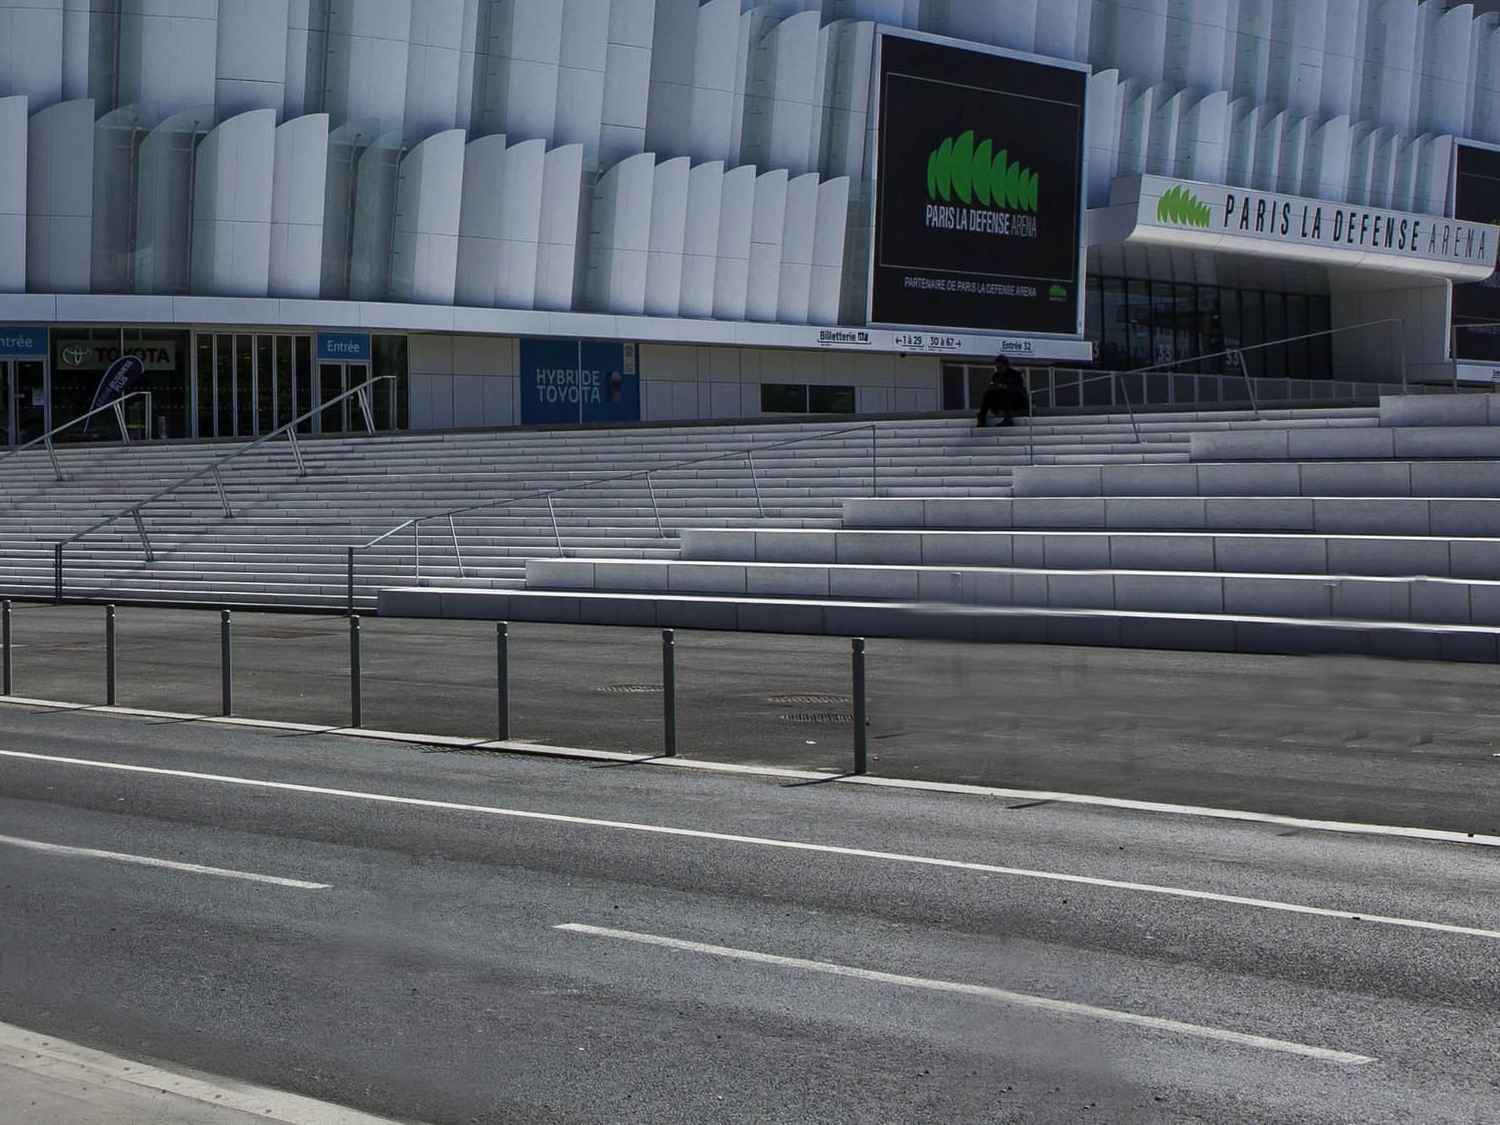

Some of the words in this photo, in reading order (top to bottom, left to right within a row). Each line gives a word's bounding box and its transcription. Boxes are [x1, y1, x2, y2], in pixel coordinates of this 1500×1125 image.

[925, 204, 955, 229] PARIS
[956, 208, 968, 231] LA
[969, 209, 1010, 235] DEFENSE
[1011, 215, 1037, 237] ARENA
[1224, 194, 1290, 235] PARIS
[1301, 205, 1321, 239] LA
[1332, 209, 1419, 252] DEFENSE
[1428, 223, 1485, 260] ARENA
[904, 276, 946, 292] PARTENAIRE
[947, 281, 957, 292] DE
[957, 282, 976, 293] PARIS
[977, 284, 985, 294] LA
[985, 284, 1015, 296] DEFENSE
[1015, 285, 1037, 297] ARENA
[820, 331, 856, 342] Billetterie
[946, 338, 955, 347] 67
[327, 340, 360, 352] Entrée
[536, 369, 601, 386] HYBRIDE
[537, 386, 602, 403] TOYOTA
